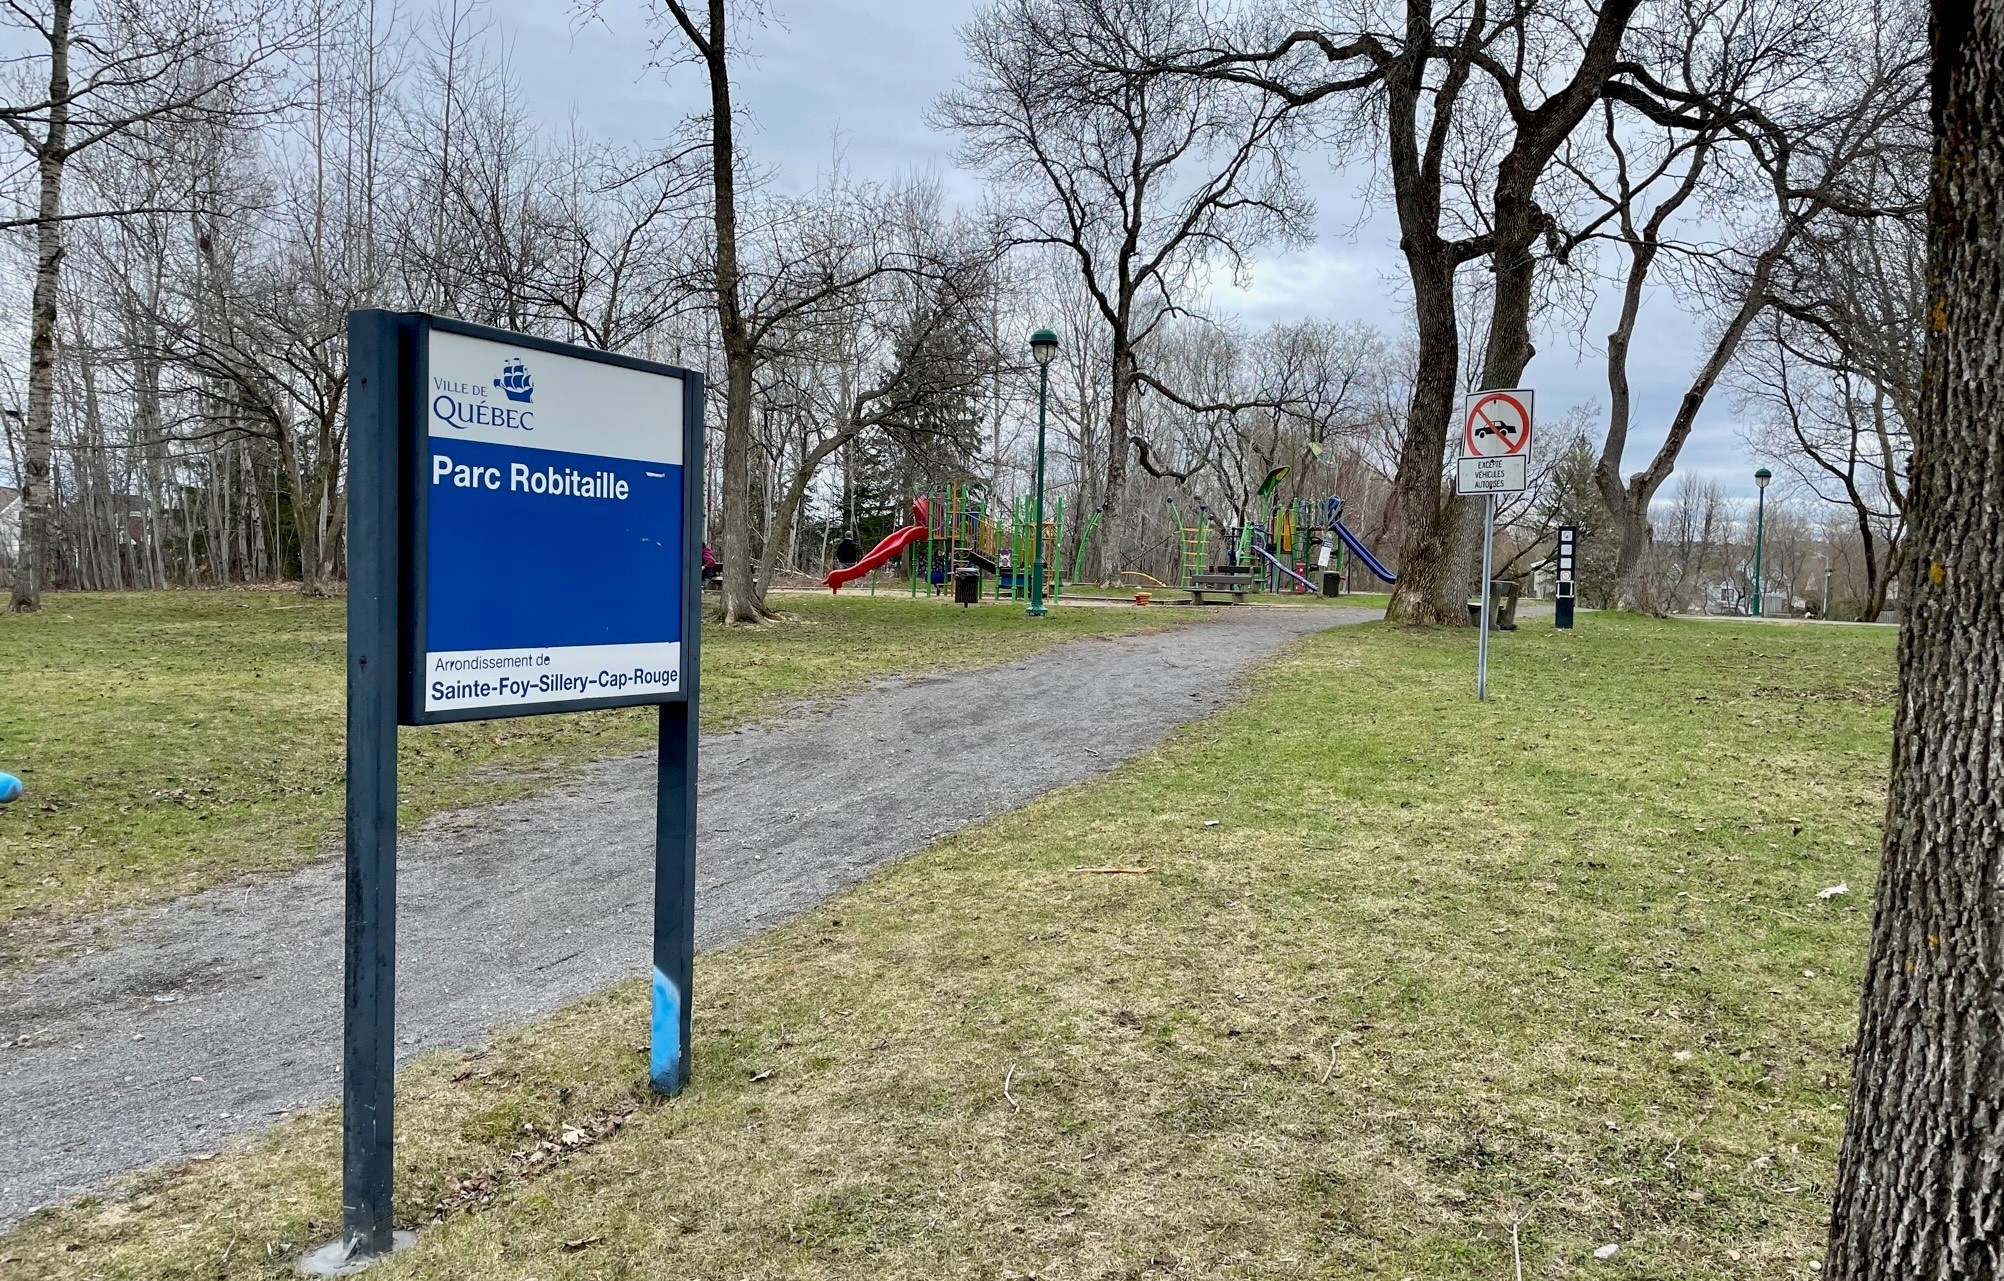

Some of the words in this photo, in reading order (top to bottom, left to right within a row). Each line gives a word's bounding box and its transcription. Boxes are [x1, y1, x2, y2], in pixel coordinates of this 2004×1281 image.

[434, 377, 467, 394] VILLE
[472, 385, 487, 397] DE
[433, 395, 533, 431] QUÉBEC
[433, 455, 500, 490] Parc
[510, 463, 629, 500] Robitaille
[435, 655, 532, 671] Arrondissement
[536, 653, 550, 666] de
